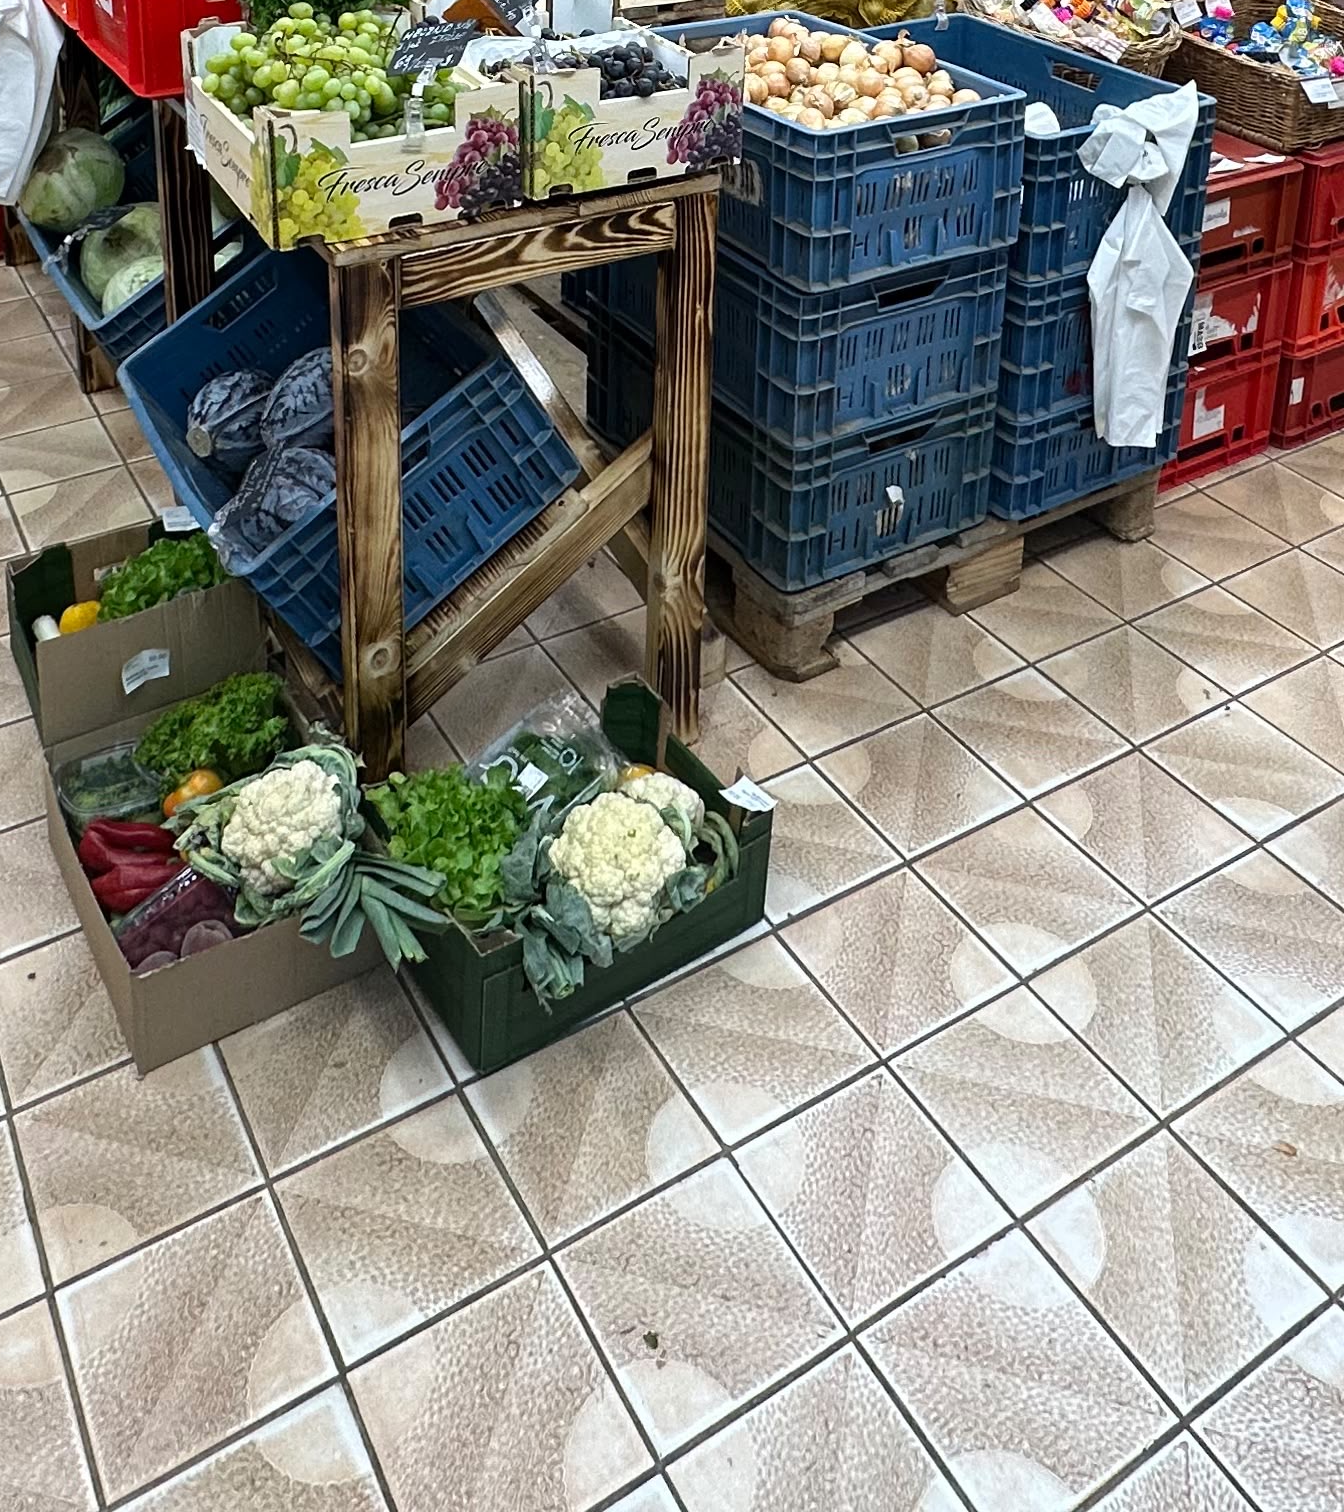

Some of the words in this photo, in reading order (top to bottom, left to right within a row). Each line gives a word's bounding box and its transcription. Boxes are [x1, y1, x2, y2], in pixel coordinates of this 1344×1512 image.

[568, 122, 637, 156] Fresca
[631, 117, 717, 151] Sempre
[318, 166, 399, 203] Fresca
[400, 158, 489, 196] Sempre
